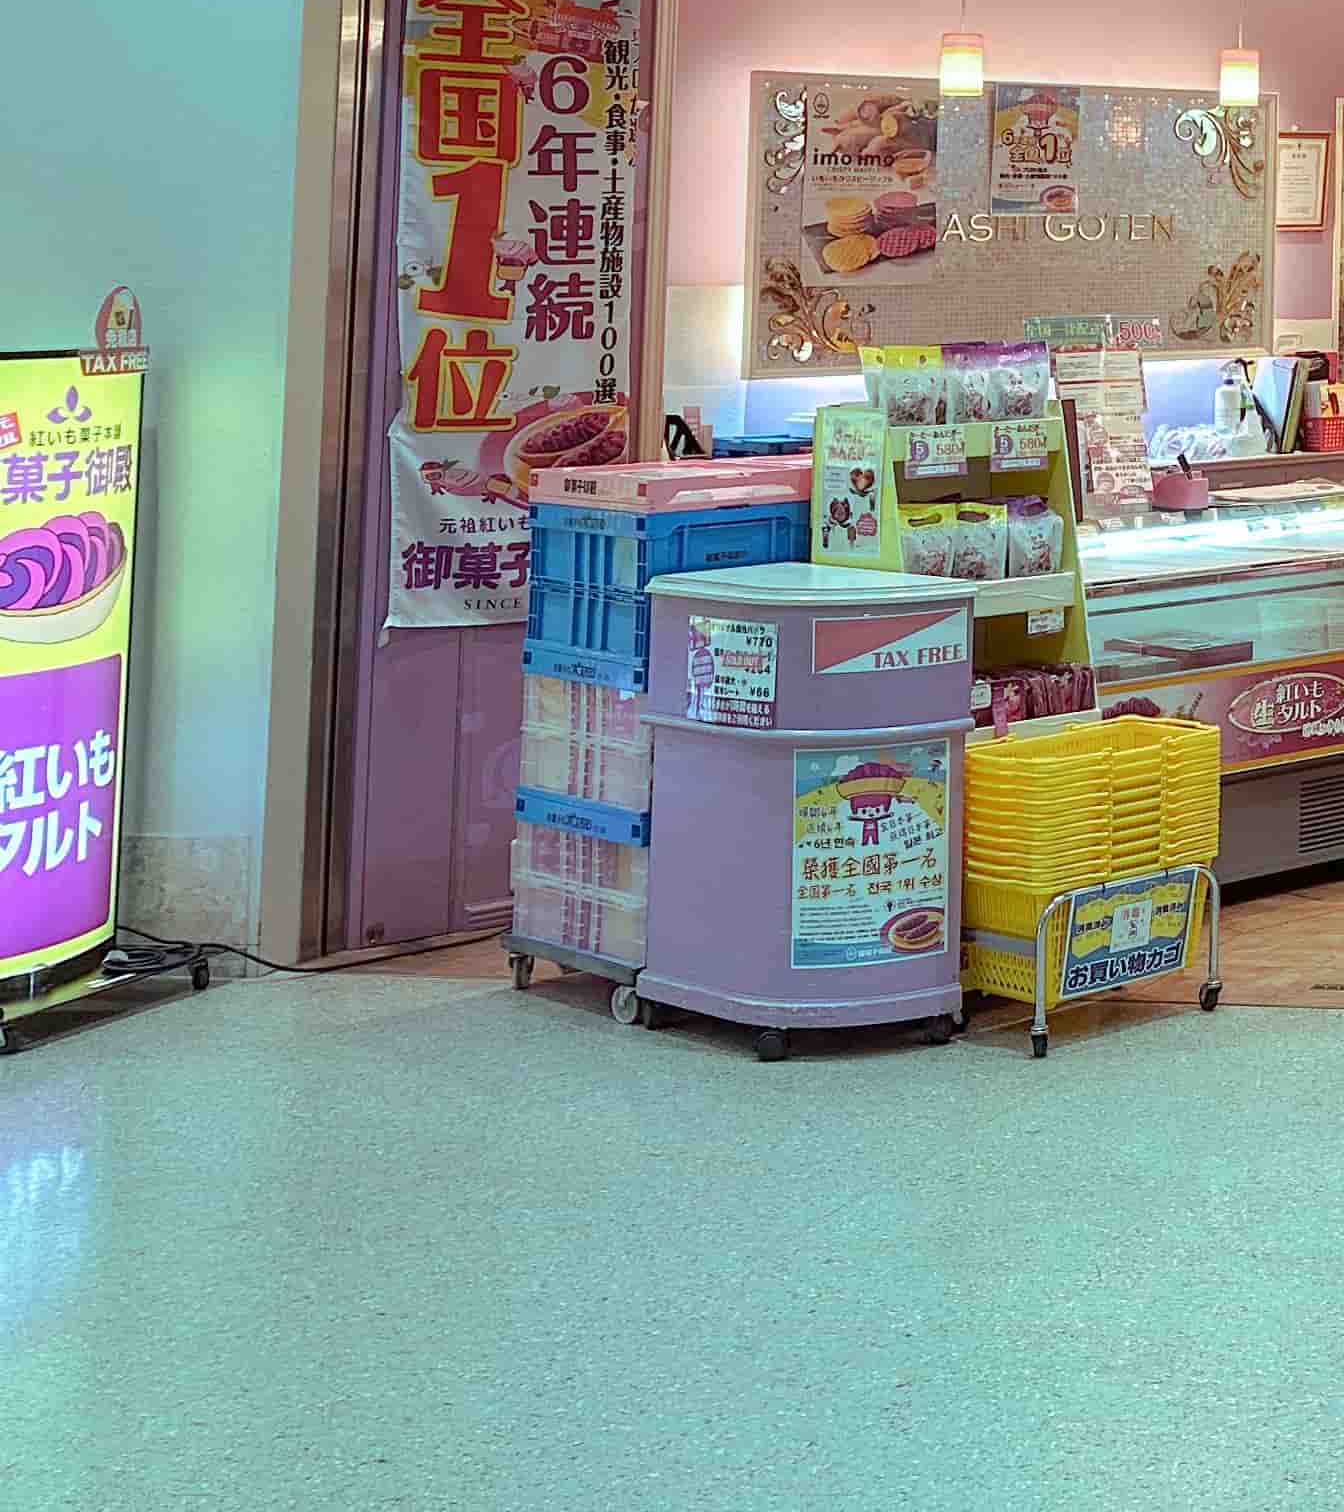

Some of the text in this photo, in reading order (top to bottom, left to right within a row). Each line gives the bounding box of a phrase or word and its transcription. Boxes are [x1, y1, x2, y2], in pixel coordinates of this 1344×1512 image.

[813, 147, 851, 167] imo
[525, 55, 600, 342] 6年連続
[1045, 213, 1174, 242] GOTEN
[82, 352, 148, 373] TAX FREE
[0, 444, 133, 504] 菓子御殿
[463, 598, 523, 610] SINCE
[872, 643, 963, 669] TAX FREE
[1275, 680, 1325, 704] 紅いも
[1253, 698, 1275, 729] 生
[1278, 700, 1322, 723] タルト
[0, 728, 116, 814] 紅いも
[1067, 941, 1184, 990] お買い物カゴ
